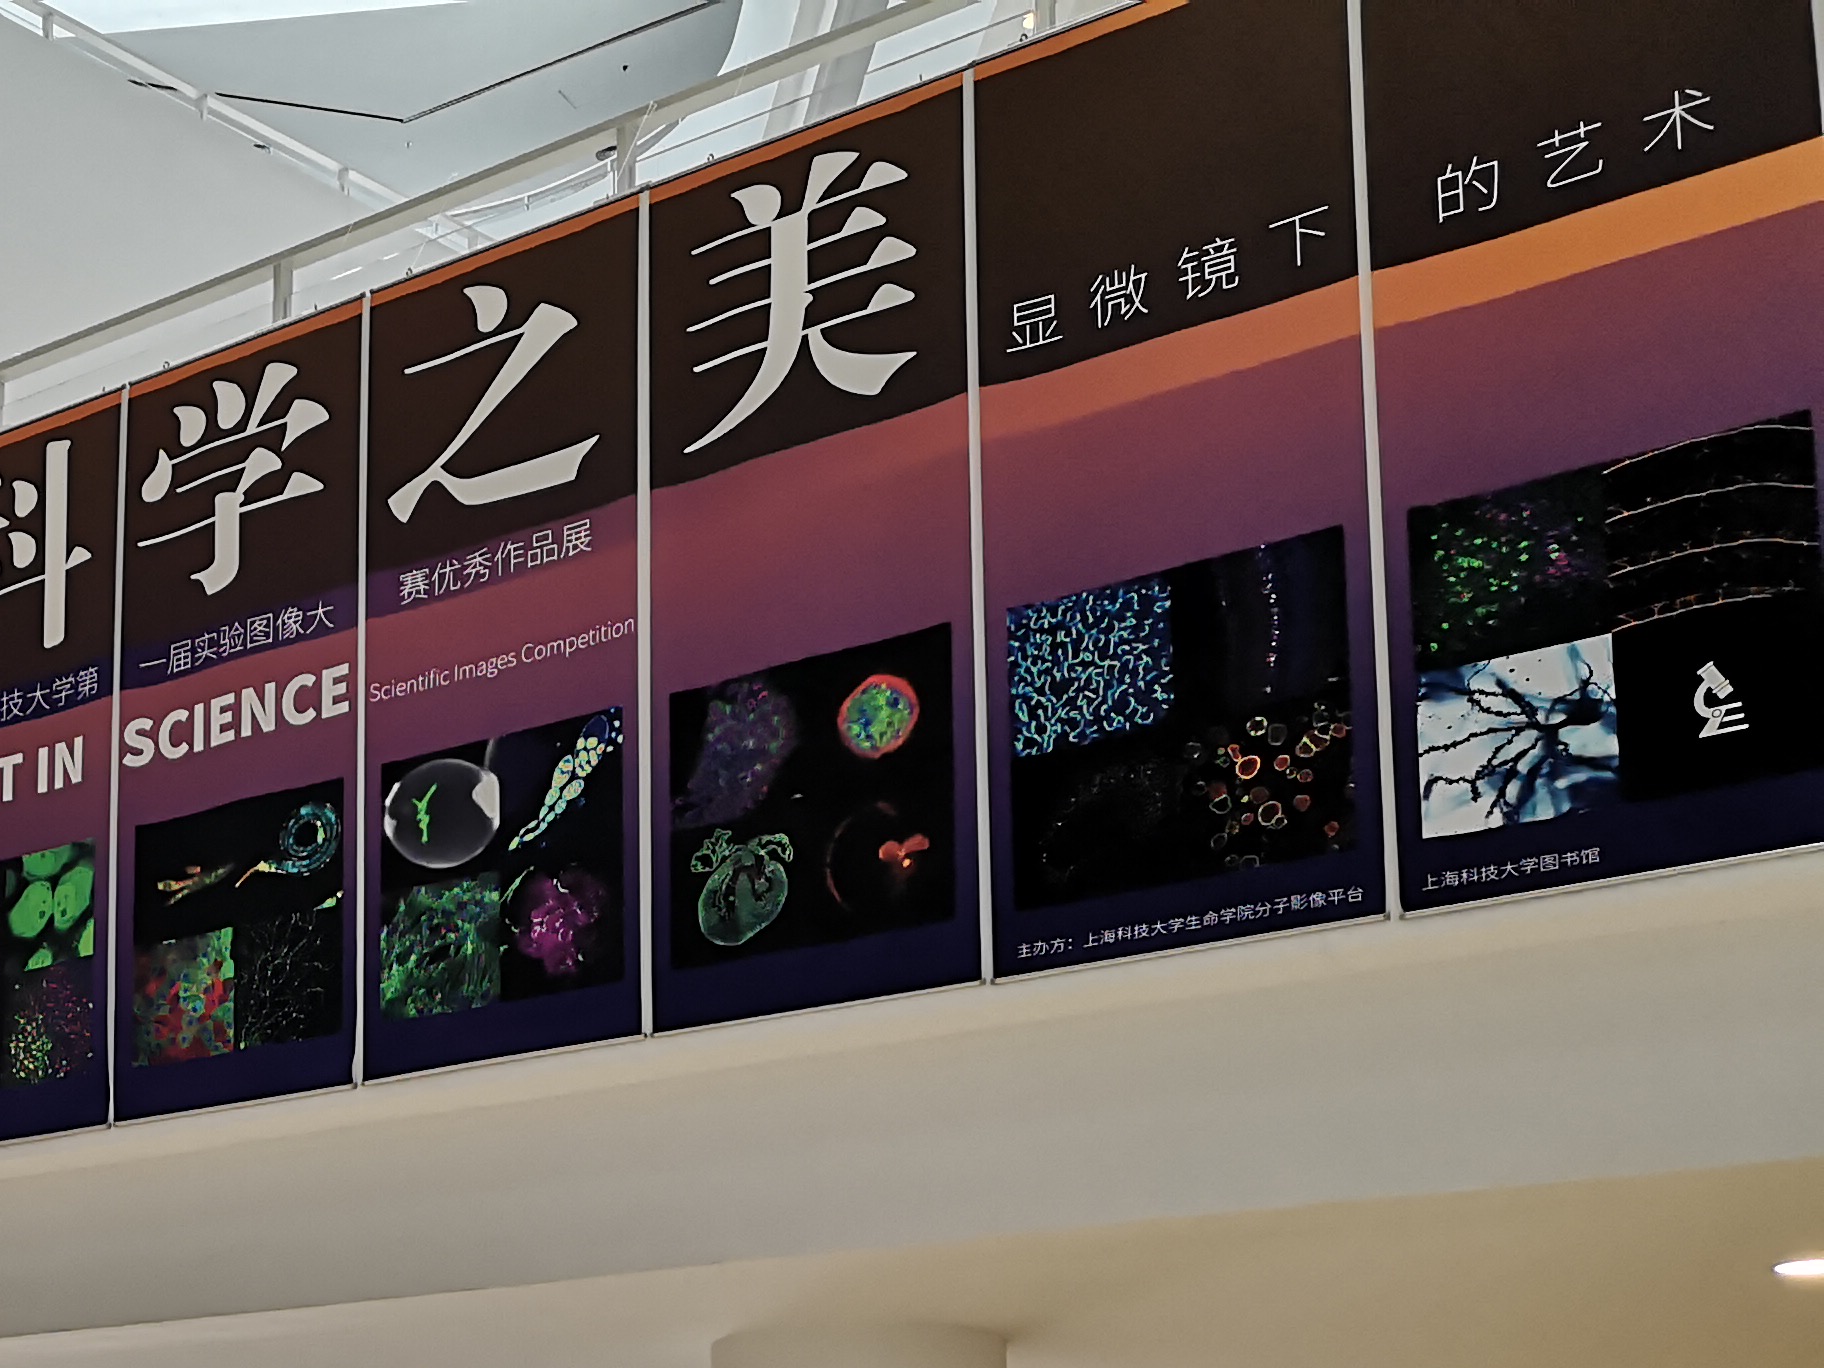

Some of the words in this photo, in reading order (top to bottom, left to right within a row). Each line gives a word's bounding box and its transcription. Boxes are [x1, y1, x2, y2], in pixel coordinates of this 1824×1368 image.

[369, 668, 451, 702] Scientific
[453, 651, 517, 683] Images
[521, 617, 635, 663] Competition
[37, 735, 84, 794] IN
[122, 662, 350, 767] SCIENCE
[1421, 847, 1601, 891] 上海科技大学图书馆
